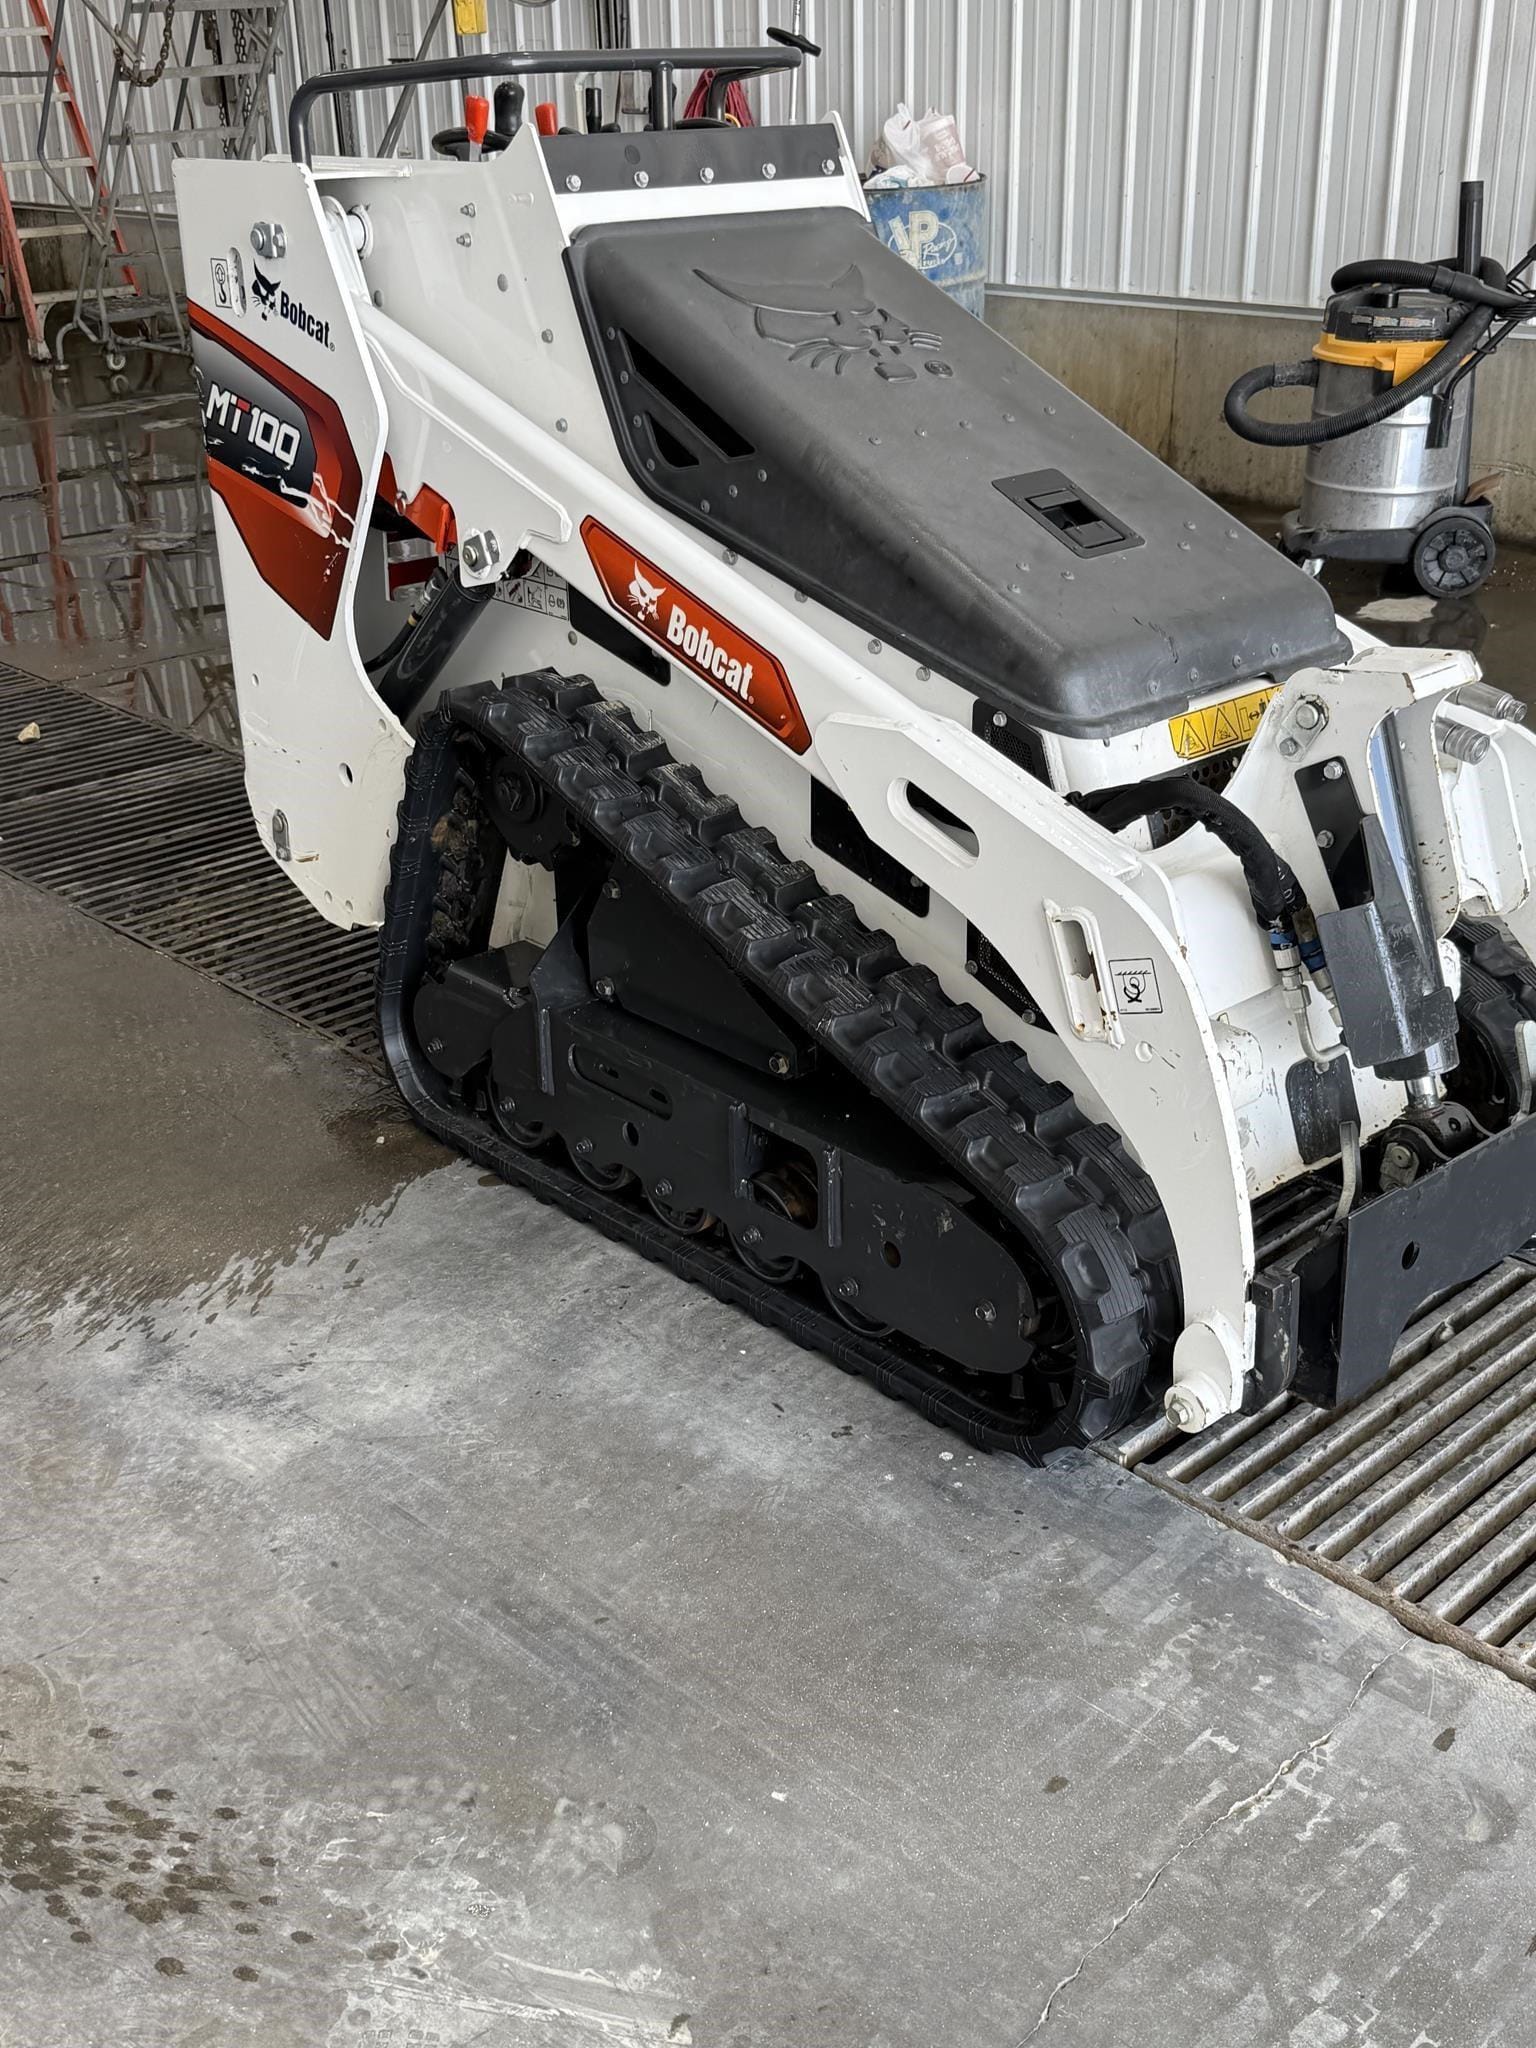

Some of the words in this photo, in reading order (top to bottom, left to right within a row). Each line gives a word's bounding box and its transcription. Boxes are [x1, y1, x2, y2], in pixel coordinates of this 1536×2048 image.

[888, 210, 938, 267] VP
[281, 291, 331, 348] Bobcat
[206, 383, 300, 468] MT100
[667, 604, 753, 700] Bobcat
